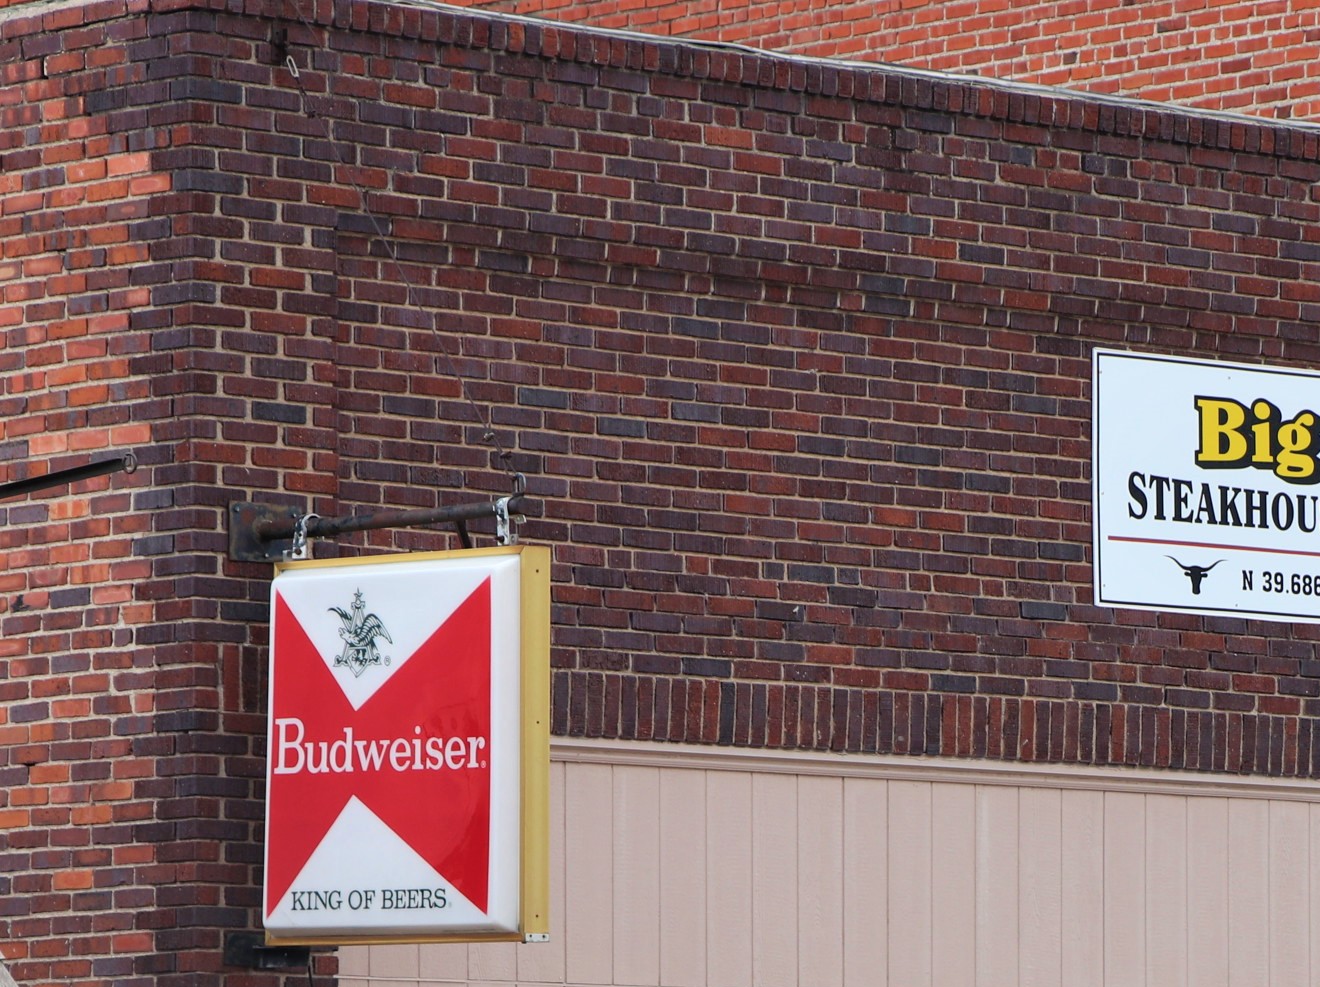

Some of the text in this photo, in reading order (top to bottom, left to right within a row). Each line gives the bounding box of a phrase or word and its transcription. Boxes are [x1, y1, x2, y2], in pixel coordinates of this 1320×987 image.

[1242, 570, 1253, 591] N
[273, 717, 485, 774] Budweiser
[290, 888, 447, 911] KING OF BEERS
